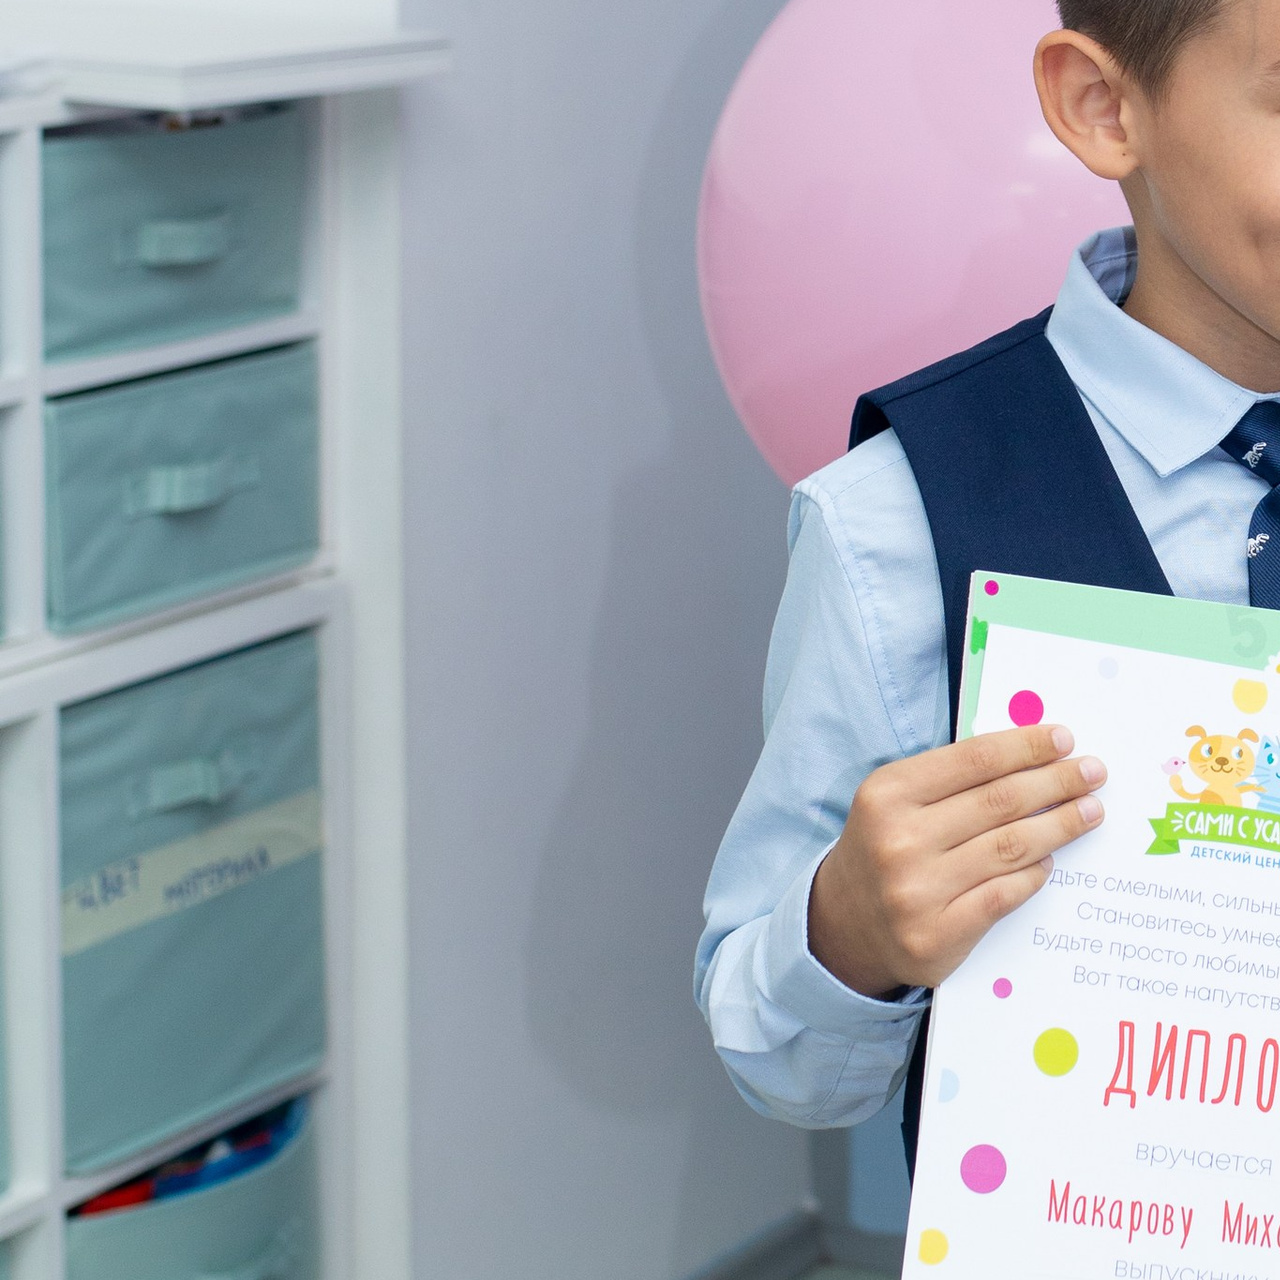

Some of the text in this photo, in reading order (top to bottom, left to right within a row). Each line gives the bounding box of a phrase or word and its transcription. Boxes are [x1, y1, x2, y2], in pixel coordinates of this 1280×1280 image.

[1185, 810, 1234, 839] САМИ
[1238, 815, 1249, 838] С
[1190, 845, 1252, 866] ДЕТСКИЙ
[1050, 866, 1097, 889] дьте
[1103, 876, 1205, 906] смелыми,
[1076, 901, 1216, 938] Становитесь
[1032, 926, 1102, 953] Будьте
[1109, 941, 1187, 966] просто
[1073, 964, 1111, 986] Вот
[1116, 974, 1178, 997] такое
[1135, 1142, 1272, 1175] вручается
[1047, 1179, 1193, 1249] Макарову
